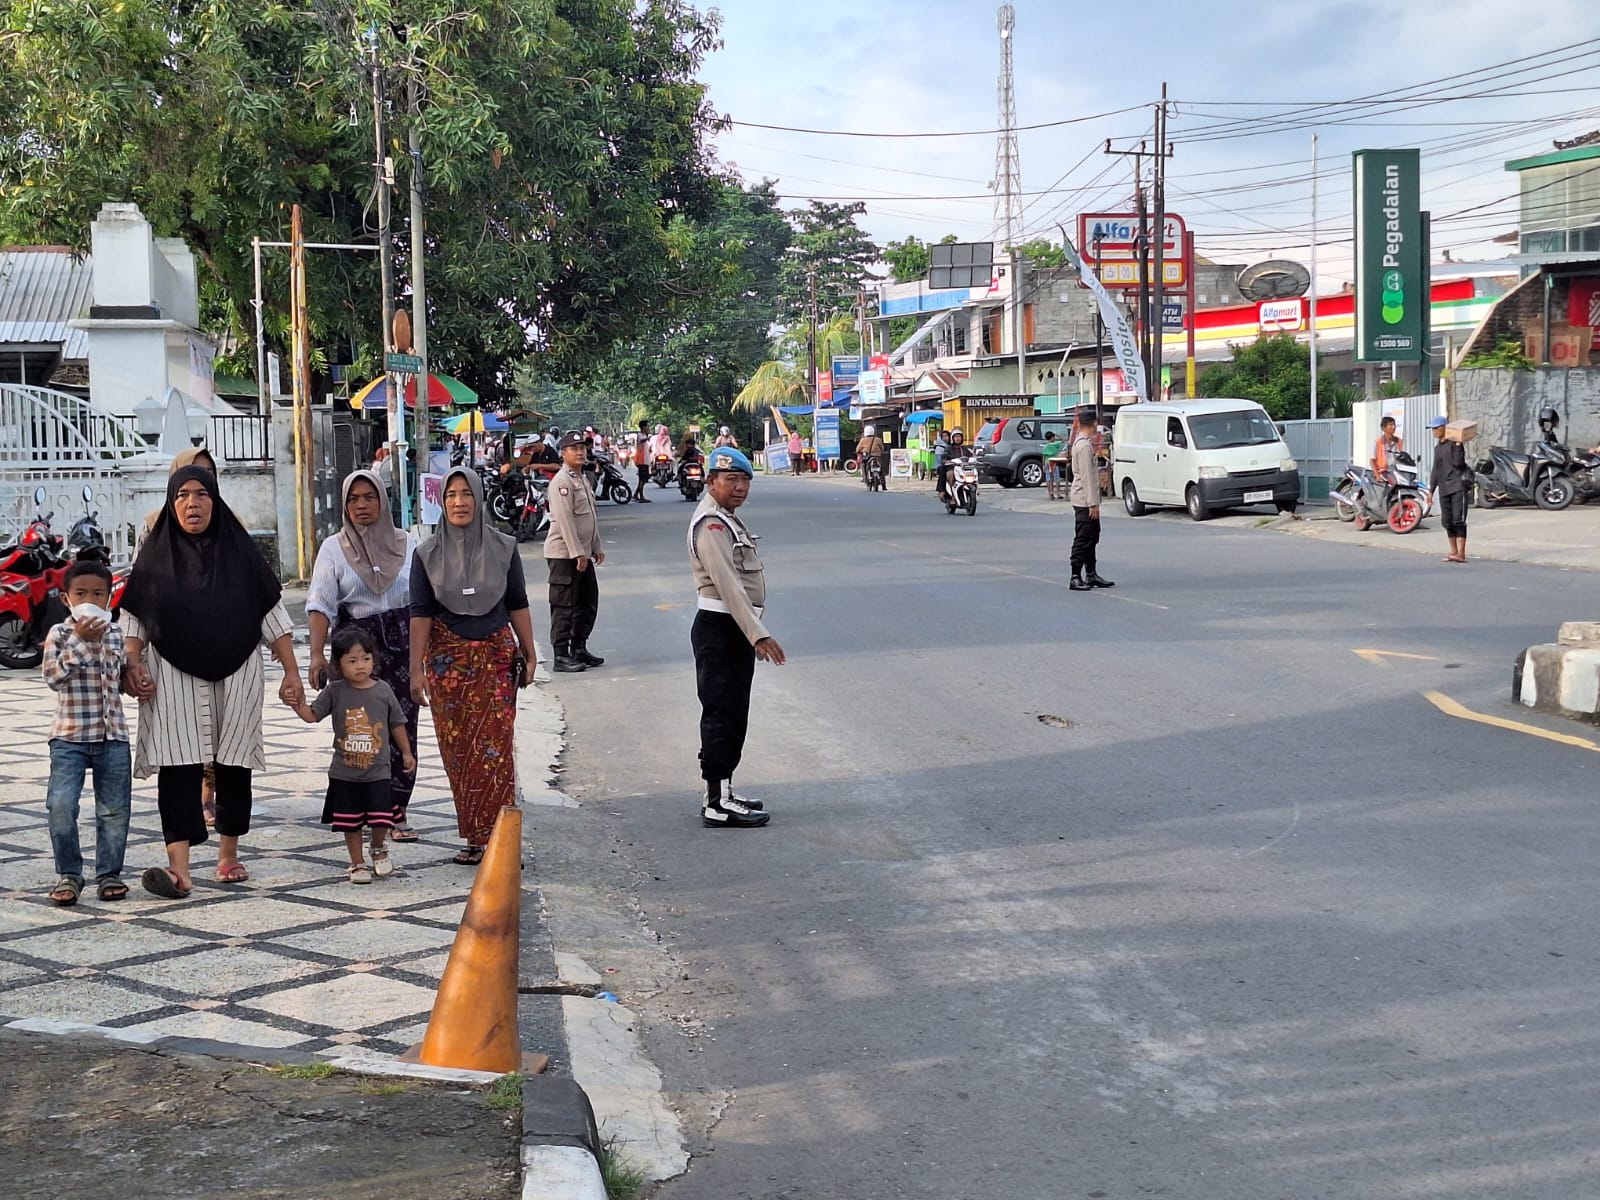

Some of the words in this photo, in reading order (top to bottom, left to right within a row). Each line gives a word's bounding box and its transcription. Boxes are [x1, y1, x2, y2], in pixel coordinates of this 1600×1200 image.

[1382, 165, 1403, 267] Pegadaian
[1263, 306, 1297, 318] Alfamart
[966, 398, 1001, 407] BINTANG
[1002, 398, 1028, 406] KEBAB
[344, 741, 372, 752] GOOD
